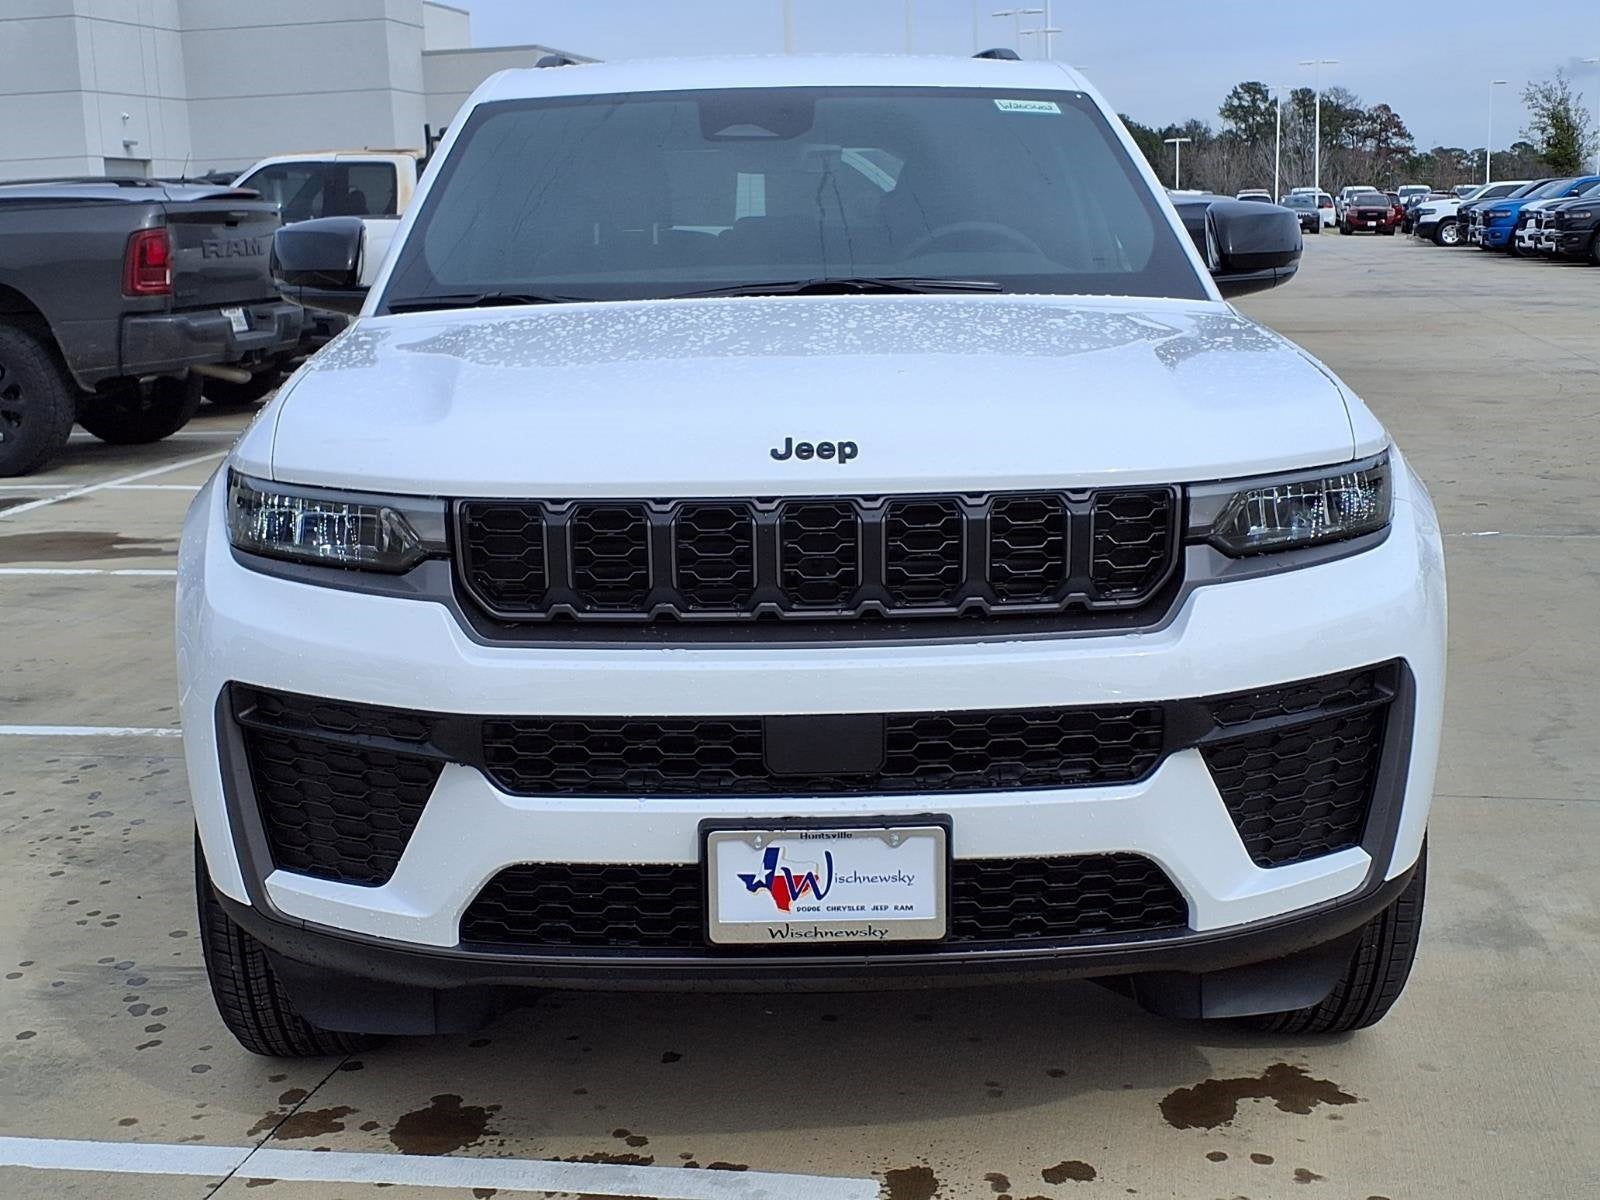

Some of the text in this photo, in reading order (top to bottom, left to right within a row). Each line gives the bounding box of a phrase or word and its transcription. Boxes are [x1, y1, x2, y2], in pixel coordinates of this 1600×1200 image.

[203, 239, 266, 258] RAM
[770, 437, 858, 464] Jeep
[800, 832, 853, 840] Huntsville
[780, 850, 915, 901] Wischnewsky
[871, 904, 889, 912] JEEP
[893, 904, 914, 912] RAM
[768, 923, 889, 940] Wischnewsky
